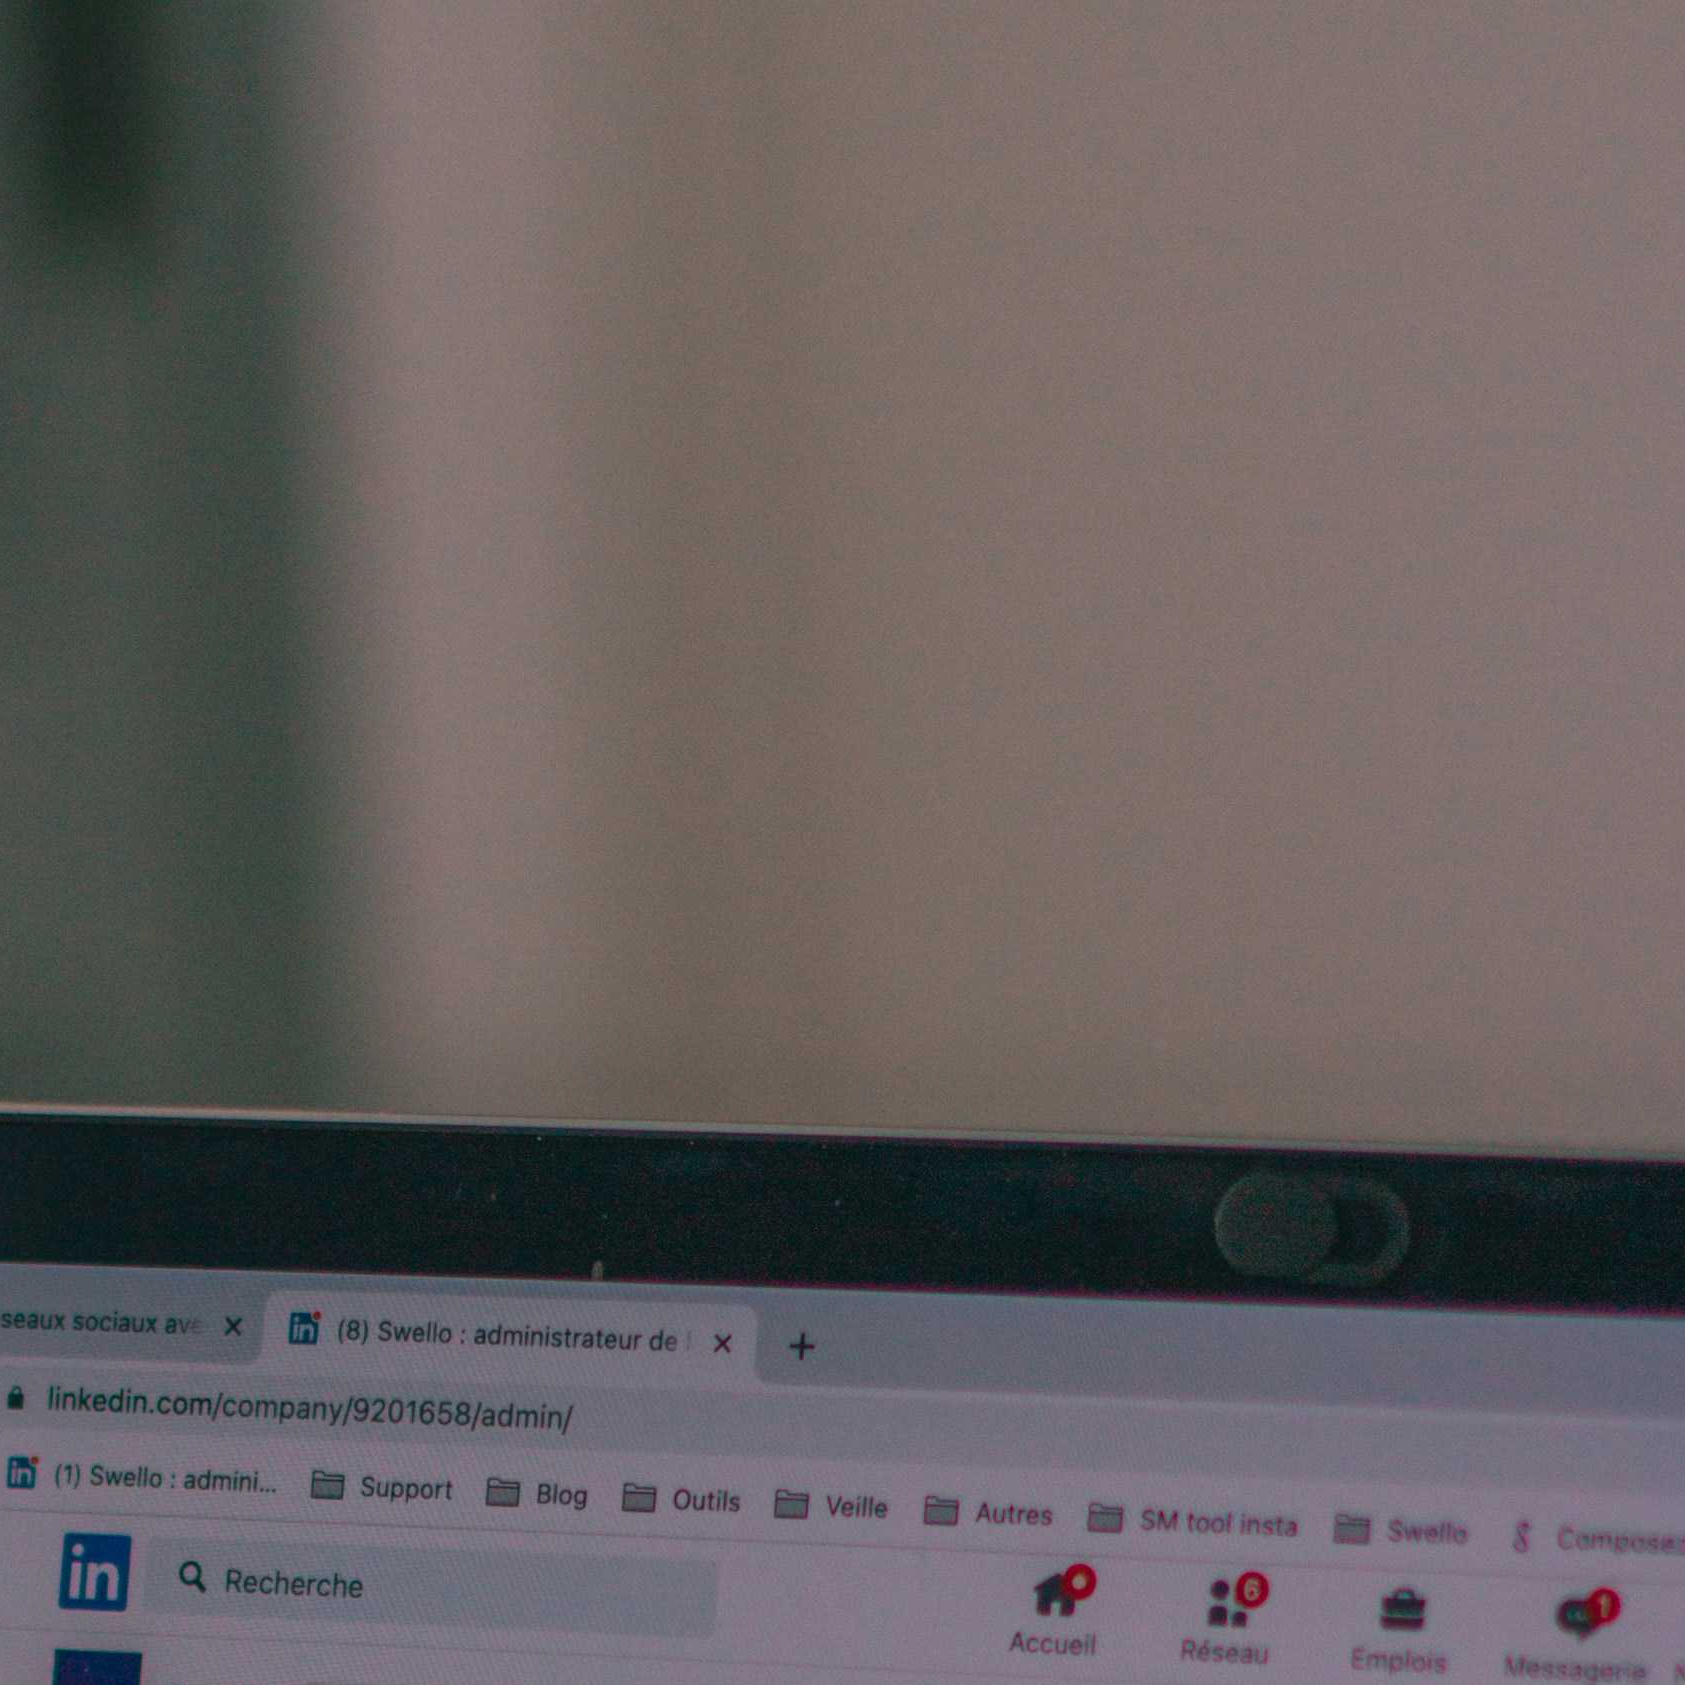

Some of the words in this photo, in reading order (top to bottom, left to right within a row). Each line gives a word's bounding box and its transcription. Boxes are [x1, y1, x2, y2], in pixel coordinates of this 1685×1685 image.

[73, 1310, 157, 1335] sociaux
[337, 1320, 369, 1344] (8)
[378, 1321, 452, 1344] Swello
[474, 1327, 641, 1352] administrateur
[650, 1330, 677, 1352] de
[49, 1386, 573, 1435] linkedin.com/company/9201658/admin/
[54, 1464, 81, 1488] (1)
[91, 1466, 162, 1489] Swello
[361, 1477, 453, 1502] Support
[538, 1484, 588, 1509] Blog
[674, 1489, 740, 1514] Outils
[826, 1495, 888, 1519] Veille
[976, 1504, 1053, 1526] Autres
[1141, 1510, 1178, 1531] SM
[1187, 1512, 1232, 1534] tool
[1240, 1512, 1299, 1537] insta
[1389, 1520, 1468, 1544] Swello
[69, 1544, 120, 1602] in
[225, 1569, 363, 1600] Recherche
[1008, 1632, 1096, 1656] Accueil
[1181, 1638, 1269, 1664] Réseau
[1352, 1649, 1447, 1676] Emplois
[1505, 1656, 1648, 1684] Messagerie
